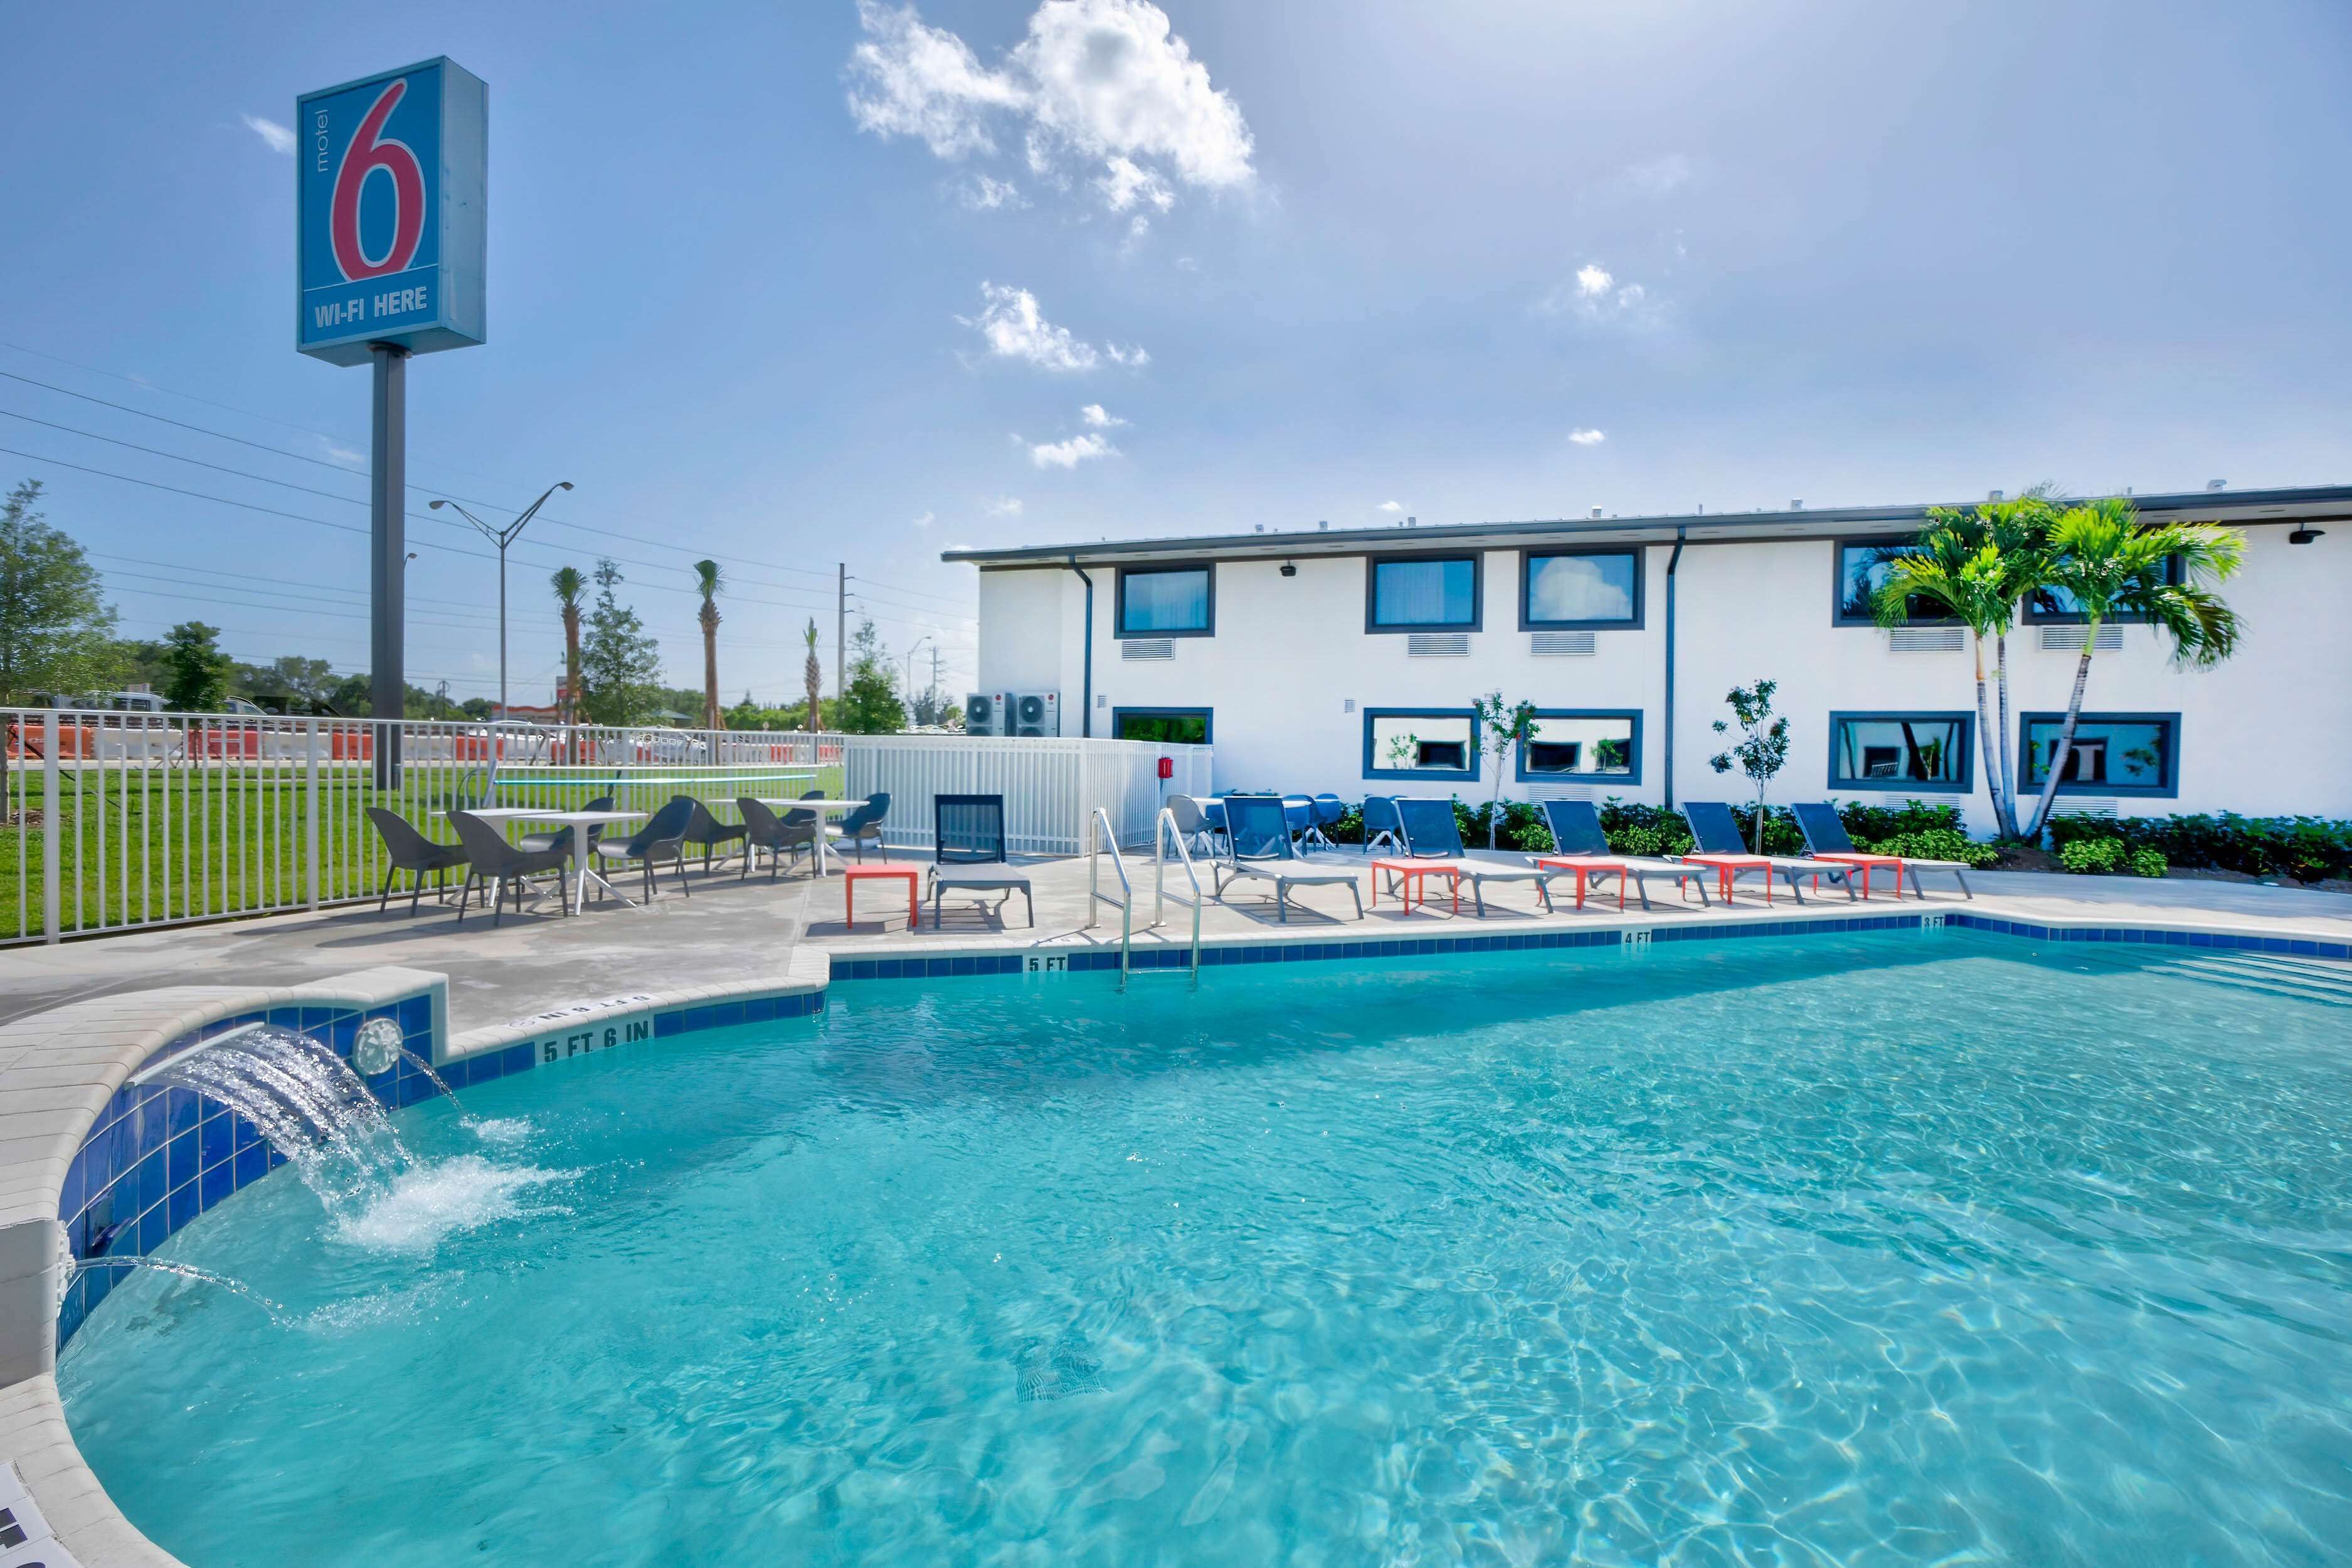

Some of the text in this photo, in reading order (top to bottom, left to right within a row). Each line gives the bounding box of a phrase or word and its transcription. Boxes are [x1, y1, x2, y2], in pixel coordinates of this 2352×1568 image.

[315, 109, 329, 172] motel
[330, 78, 426, 282] 6
[315, 286, 428, 327] WI-FI HERE
[1625, 932, 1650, 943] 4 FT
[1029, 956, 1066, 972] 5 FT
[544, 1041, 558, 1062] 5
[604, 1028, 617, 1047] 6
[627, 1020, 649, 1043] IN
